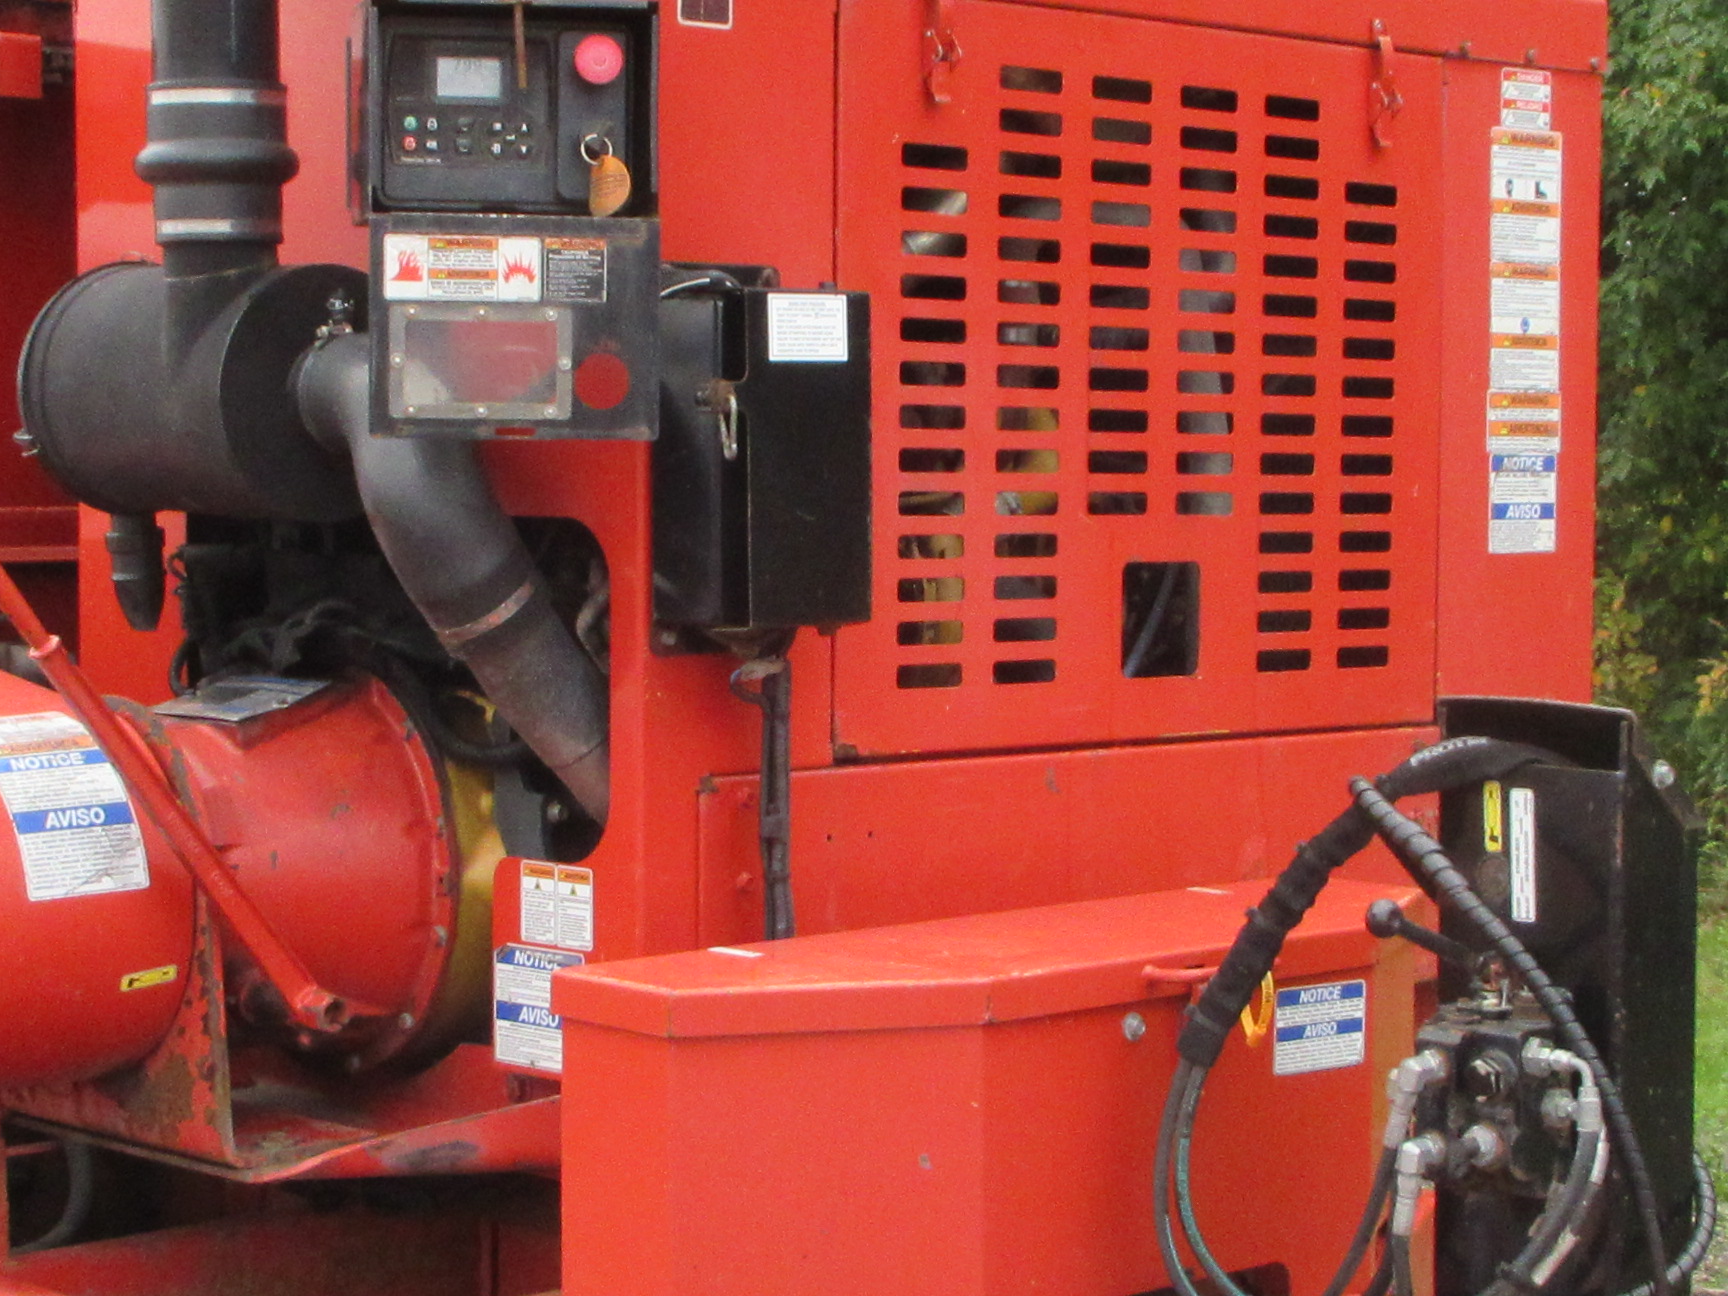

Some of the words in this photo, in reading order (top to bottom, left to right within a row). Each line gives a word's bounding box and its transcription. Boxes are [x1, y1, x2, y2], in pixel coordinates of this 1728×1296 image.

[1502, 457, 1545, 471] NOTICE
[1505, 504, 1541, 520] AVISO
[9, 752, 86, 772] NOTICE
[45, 807, 106, 829] AVISO
[1299, 985, 1343, 1004] NOTICE
[1303, 1021, 1338, 1039] AVISO
